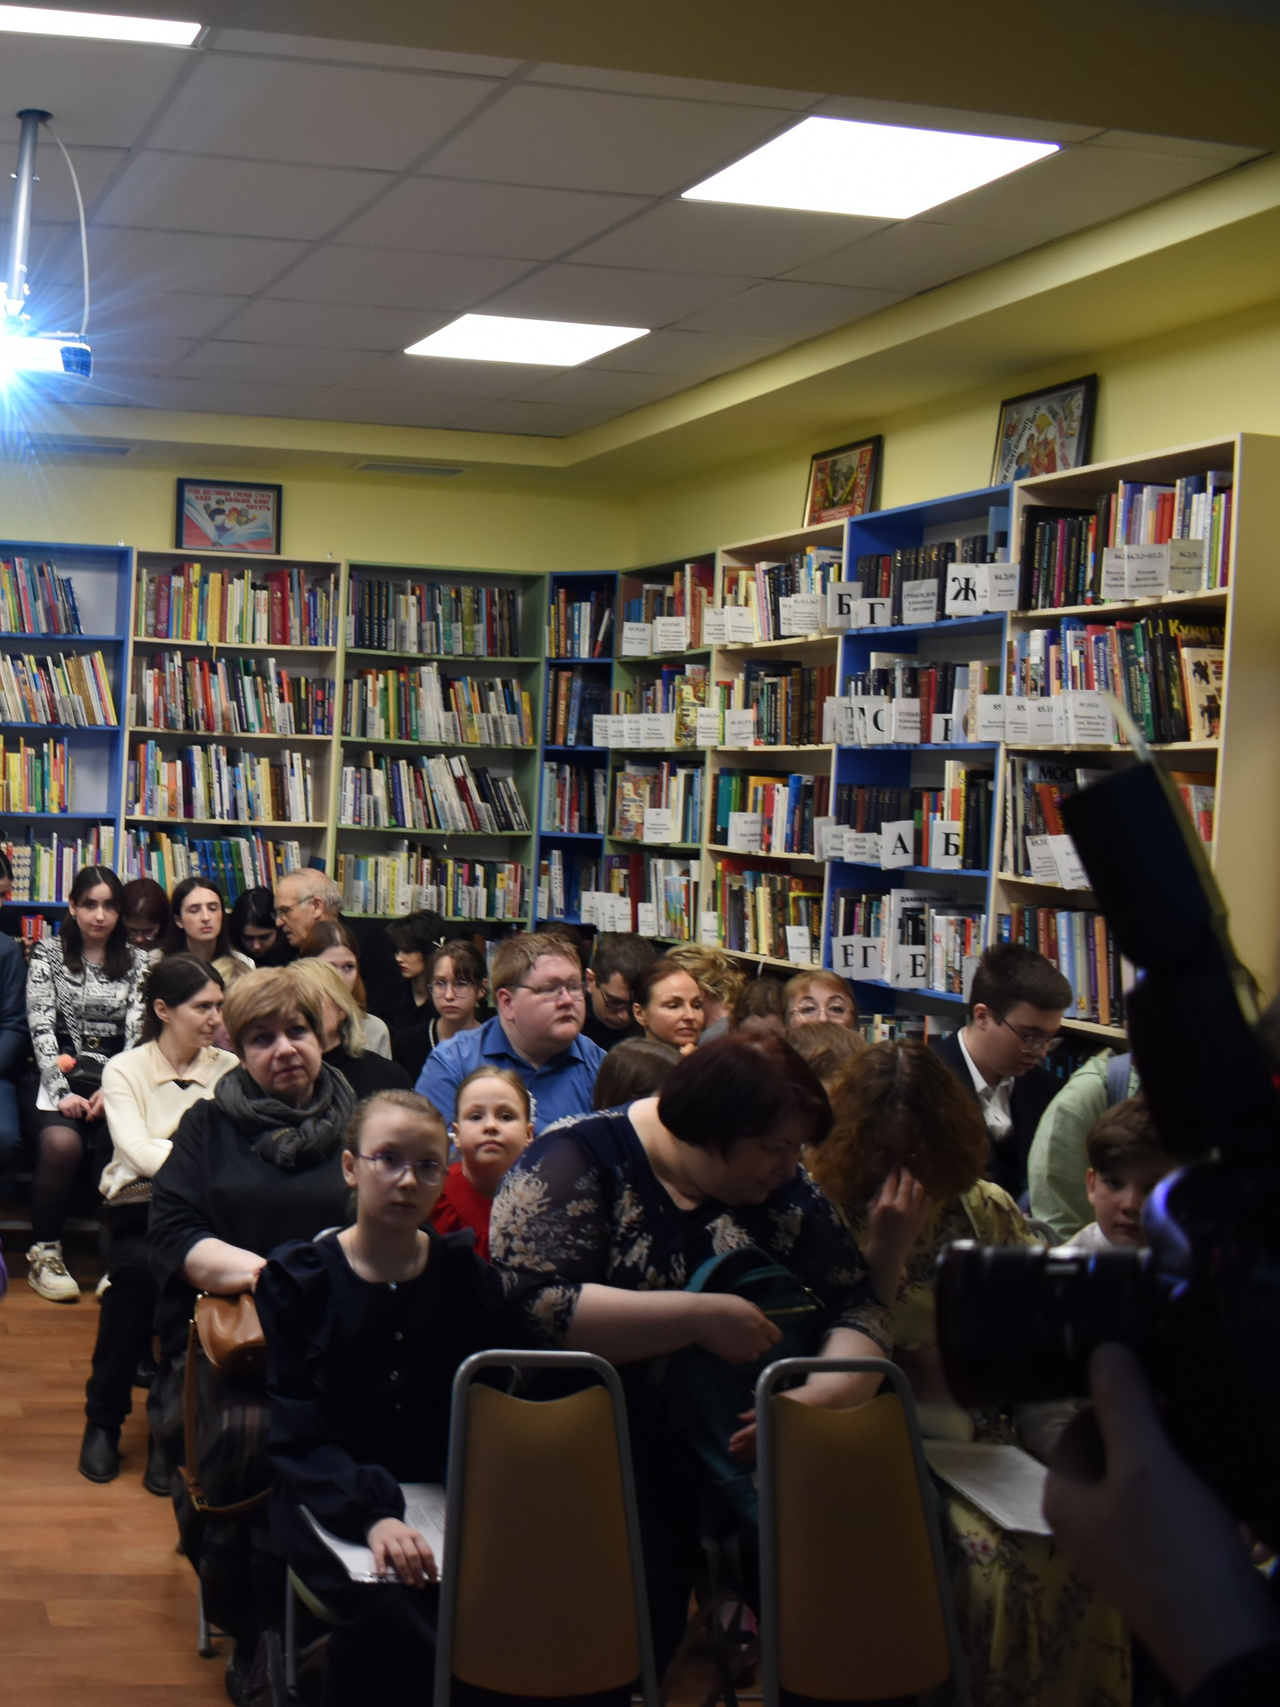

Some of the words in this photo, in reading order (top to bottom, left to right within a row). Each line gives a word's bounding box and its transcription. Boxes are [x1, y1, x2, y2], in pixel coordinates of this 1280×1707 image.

[951, 577, 977, 602] Ж
[838, 594, 852, 616] Б
[868, 602, 886, 625] Г
[892, 832, 910, 855] А
[943, 832, 960, 856] Б
[860, 945, 877, 968] Г
